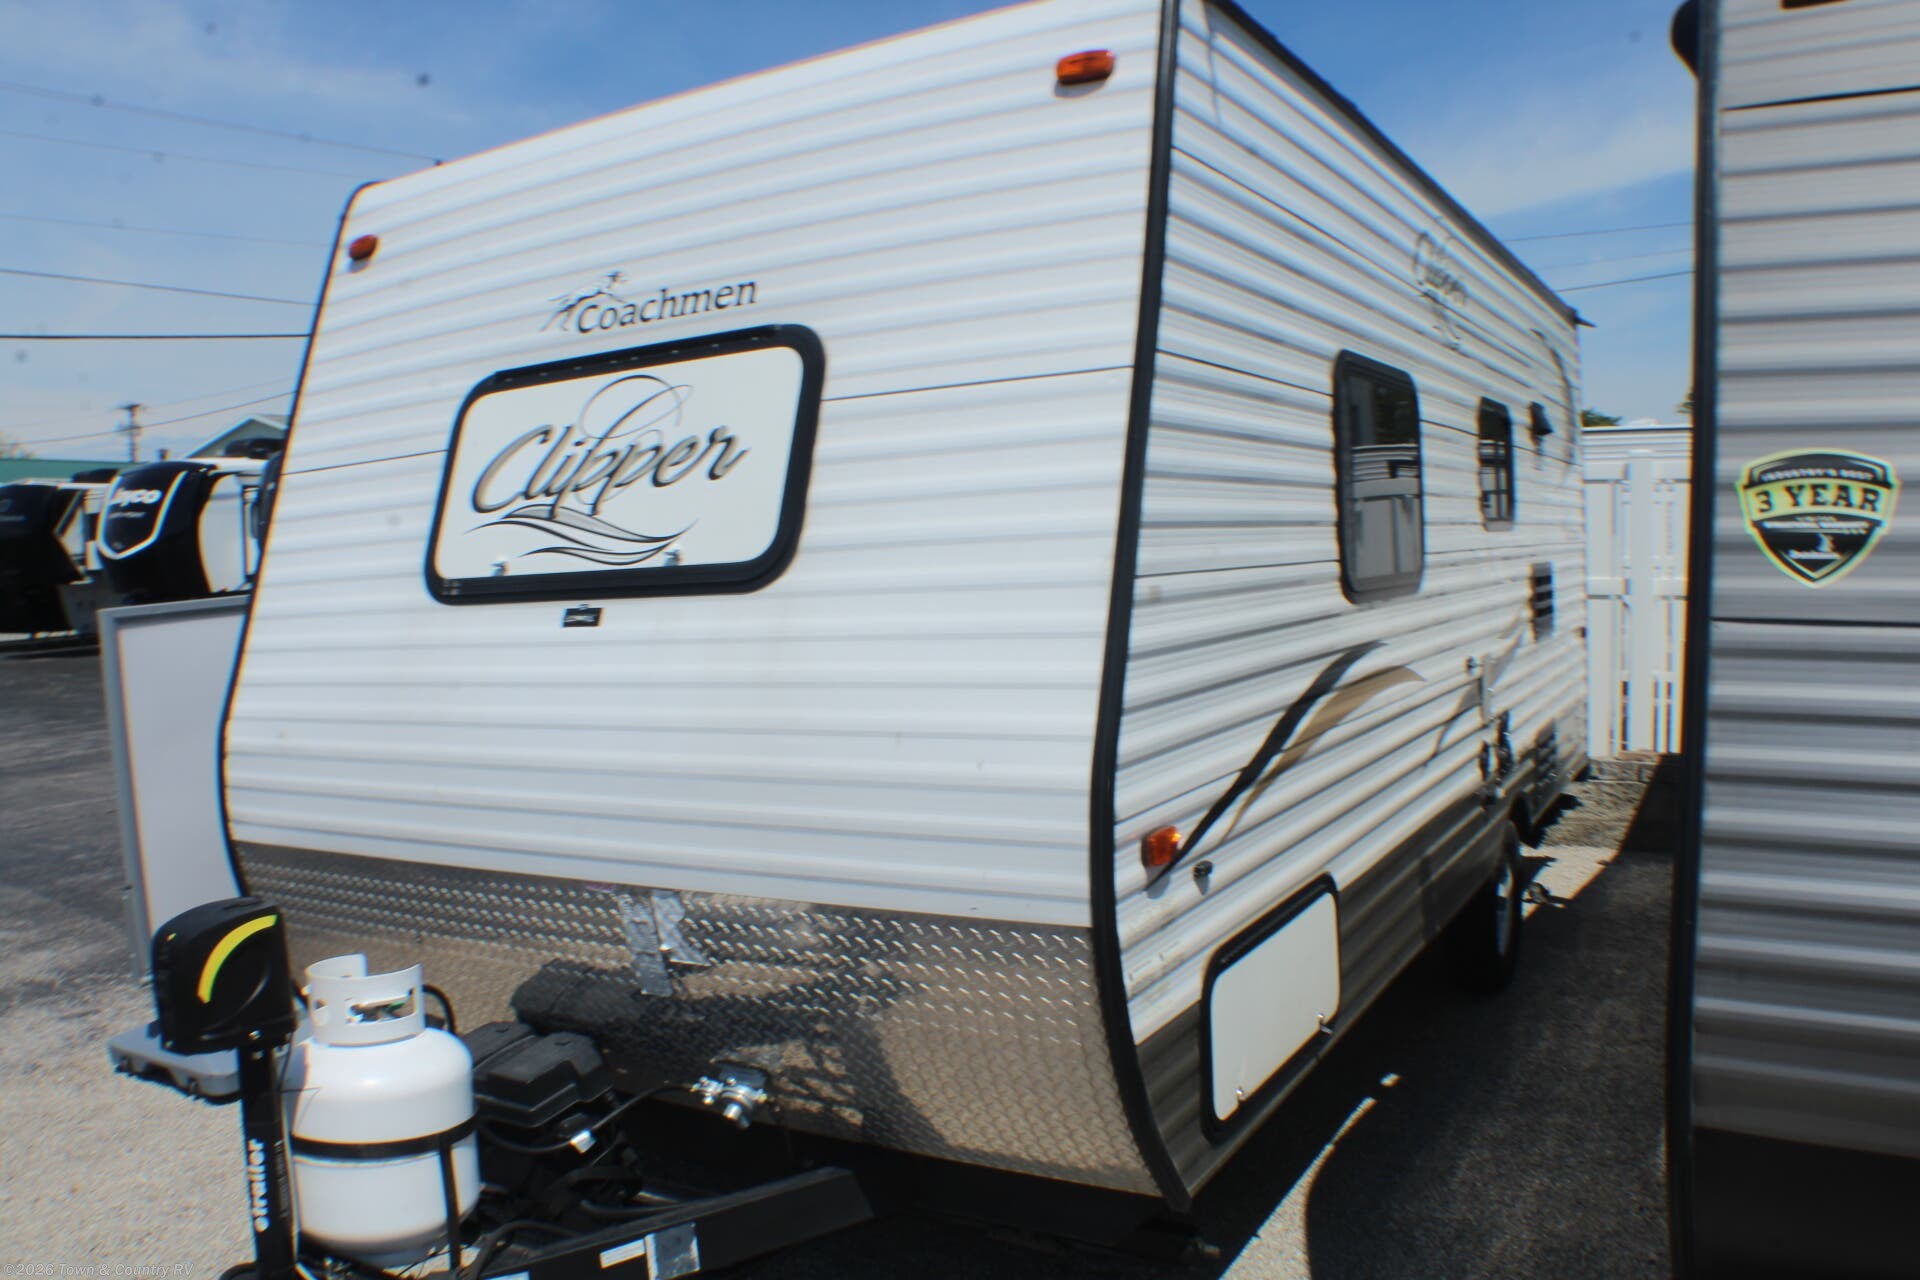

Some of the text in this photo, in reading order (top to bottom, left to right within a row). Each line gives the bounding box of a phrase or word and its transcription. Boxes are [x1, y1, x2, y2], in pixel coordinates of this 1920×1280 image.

[577, 281, 757, 333] Coachmen
[472, 375, 750, 521] Clipper
[1755, 484, 1880, 513] 3 YEAR
[247, 1138, 270, 1233] etrailer
